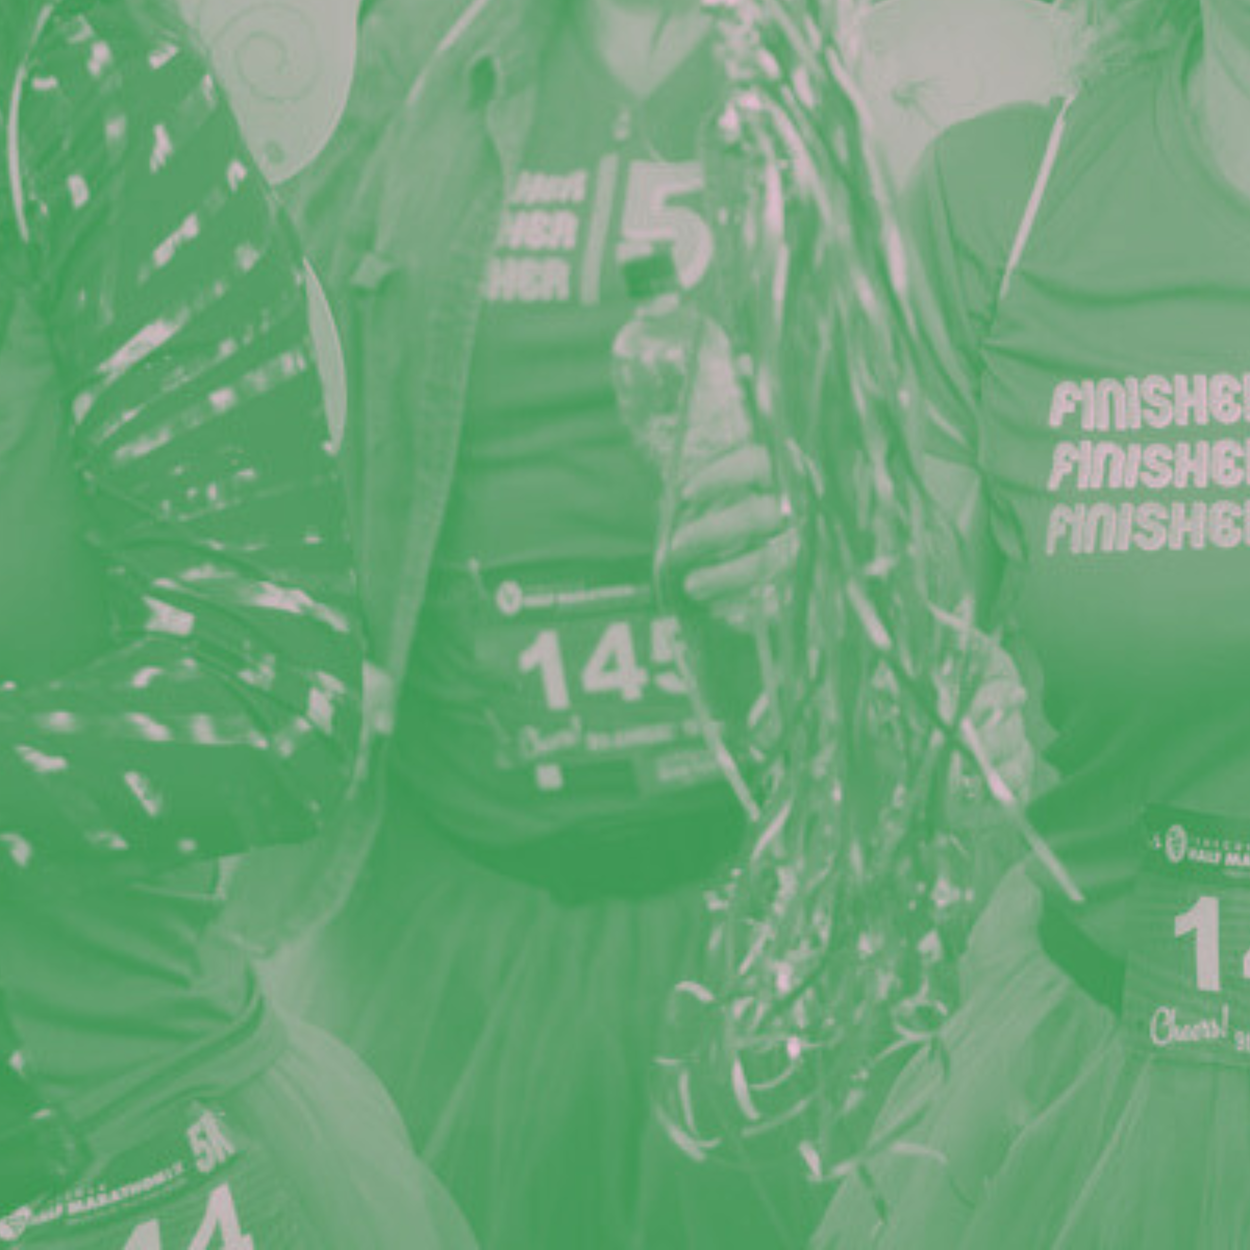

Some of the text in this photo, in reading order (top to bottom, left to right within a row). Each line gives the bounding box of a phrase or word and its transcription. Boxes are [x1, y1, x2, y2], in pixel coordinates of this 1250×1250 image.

[614, 158, 714, 291] 5
[518, 616, 690, 712] 145
[187, 1109, 237, 1173] 5K
